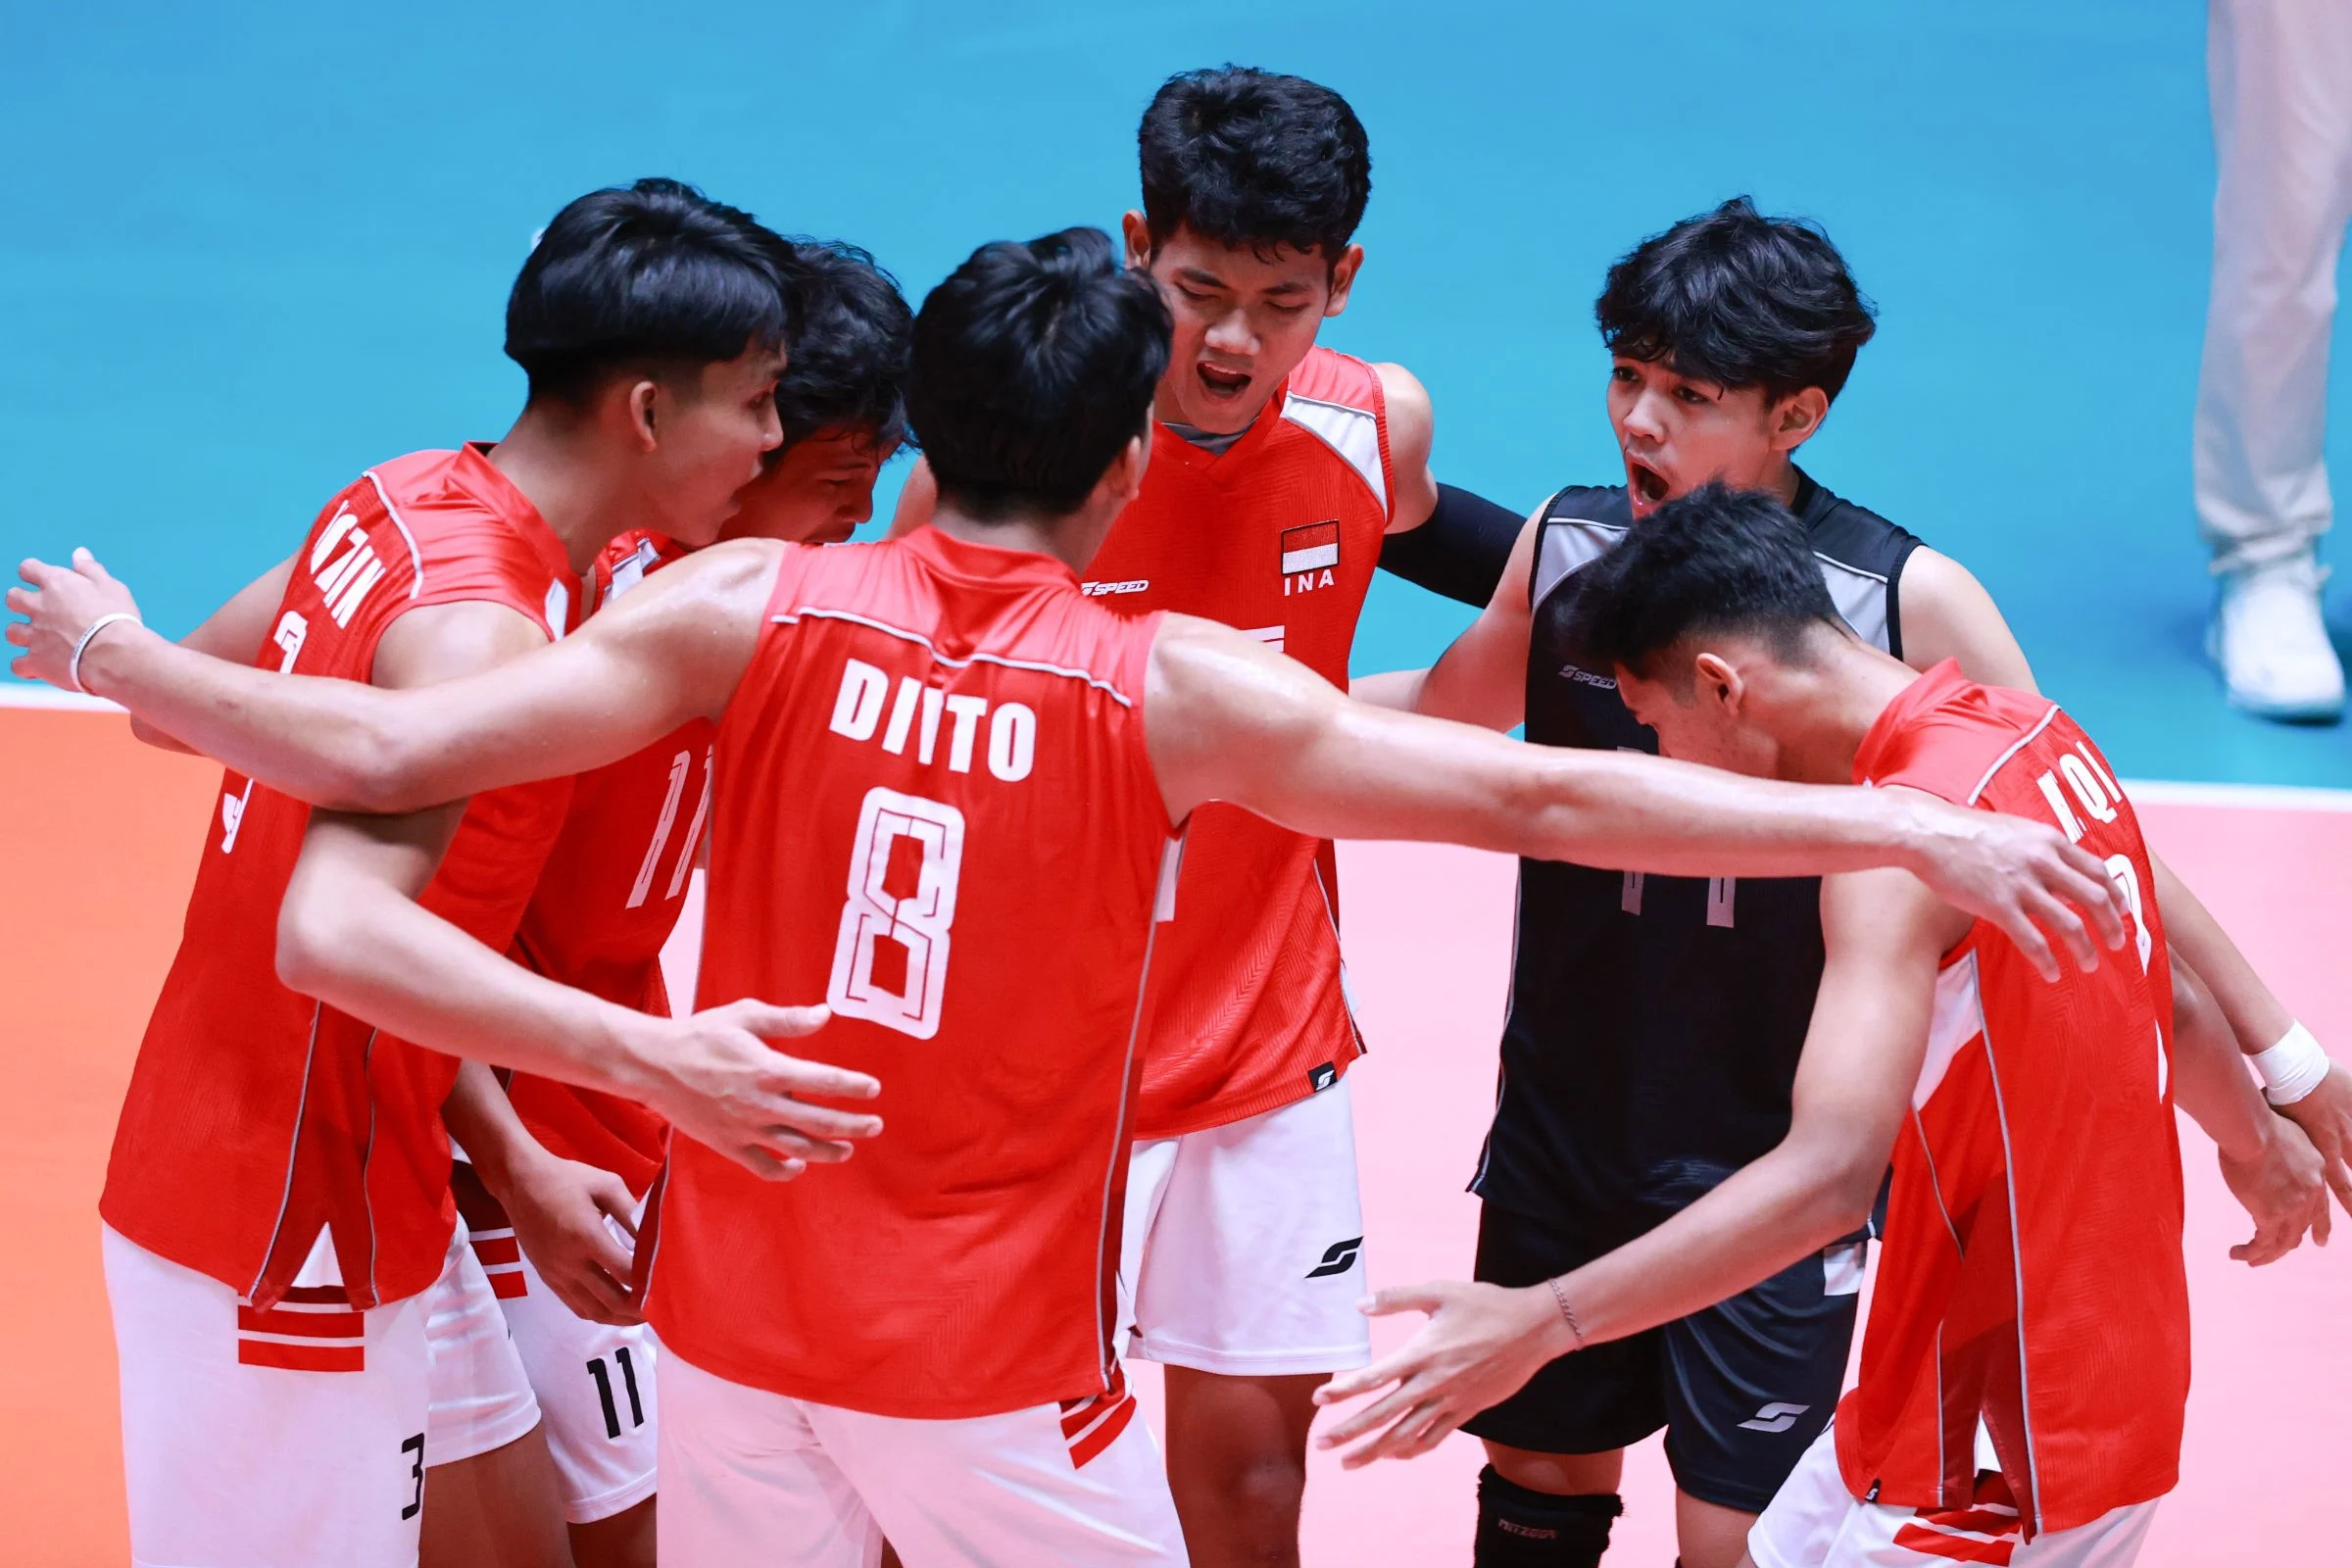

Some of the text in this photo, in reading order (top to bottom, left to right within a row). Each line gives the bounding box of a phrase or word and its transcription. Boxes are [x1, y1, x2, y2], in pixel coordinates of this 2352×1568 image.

[1091, 579, 1150, 596] SPEED
[1284, 569, 1335, 596] INA
[1572, 670, 1617, 690] SPEED
[625, 745, 713, 909] 11
[826, 786, 965, 1040] 8
[586, 1347, 645, 1440] 11
[401, 1432, 425, 1521] 3
